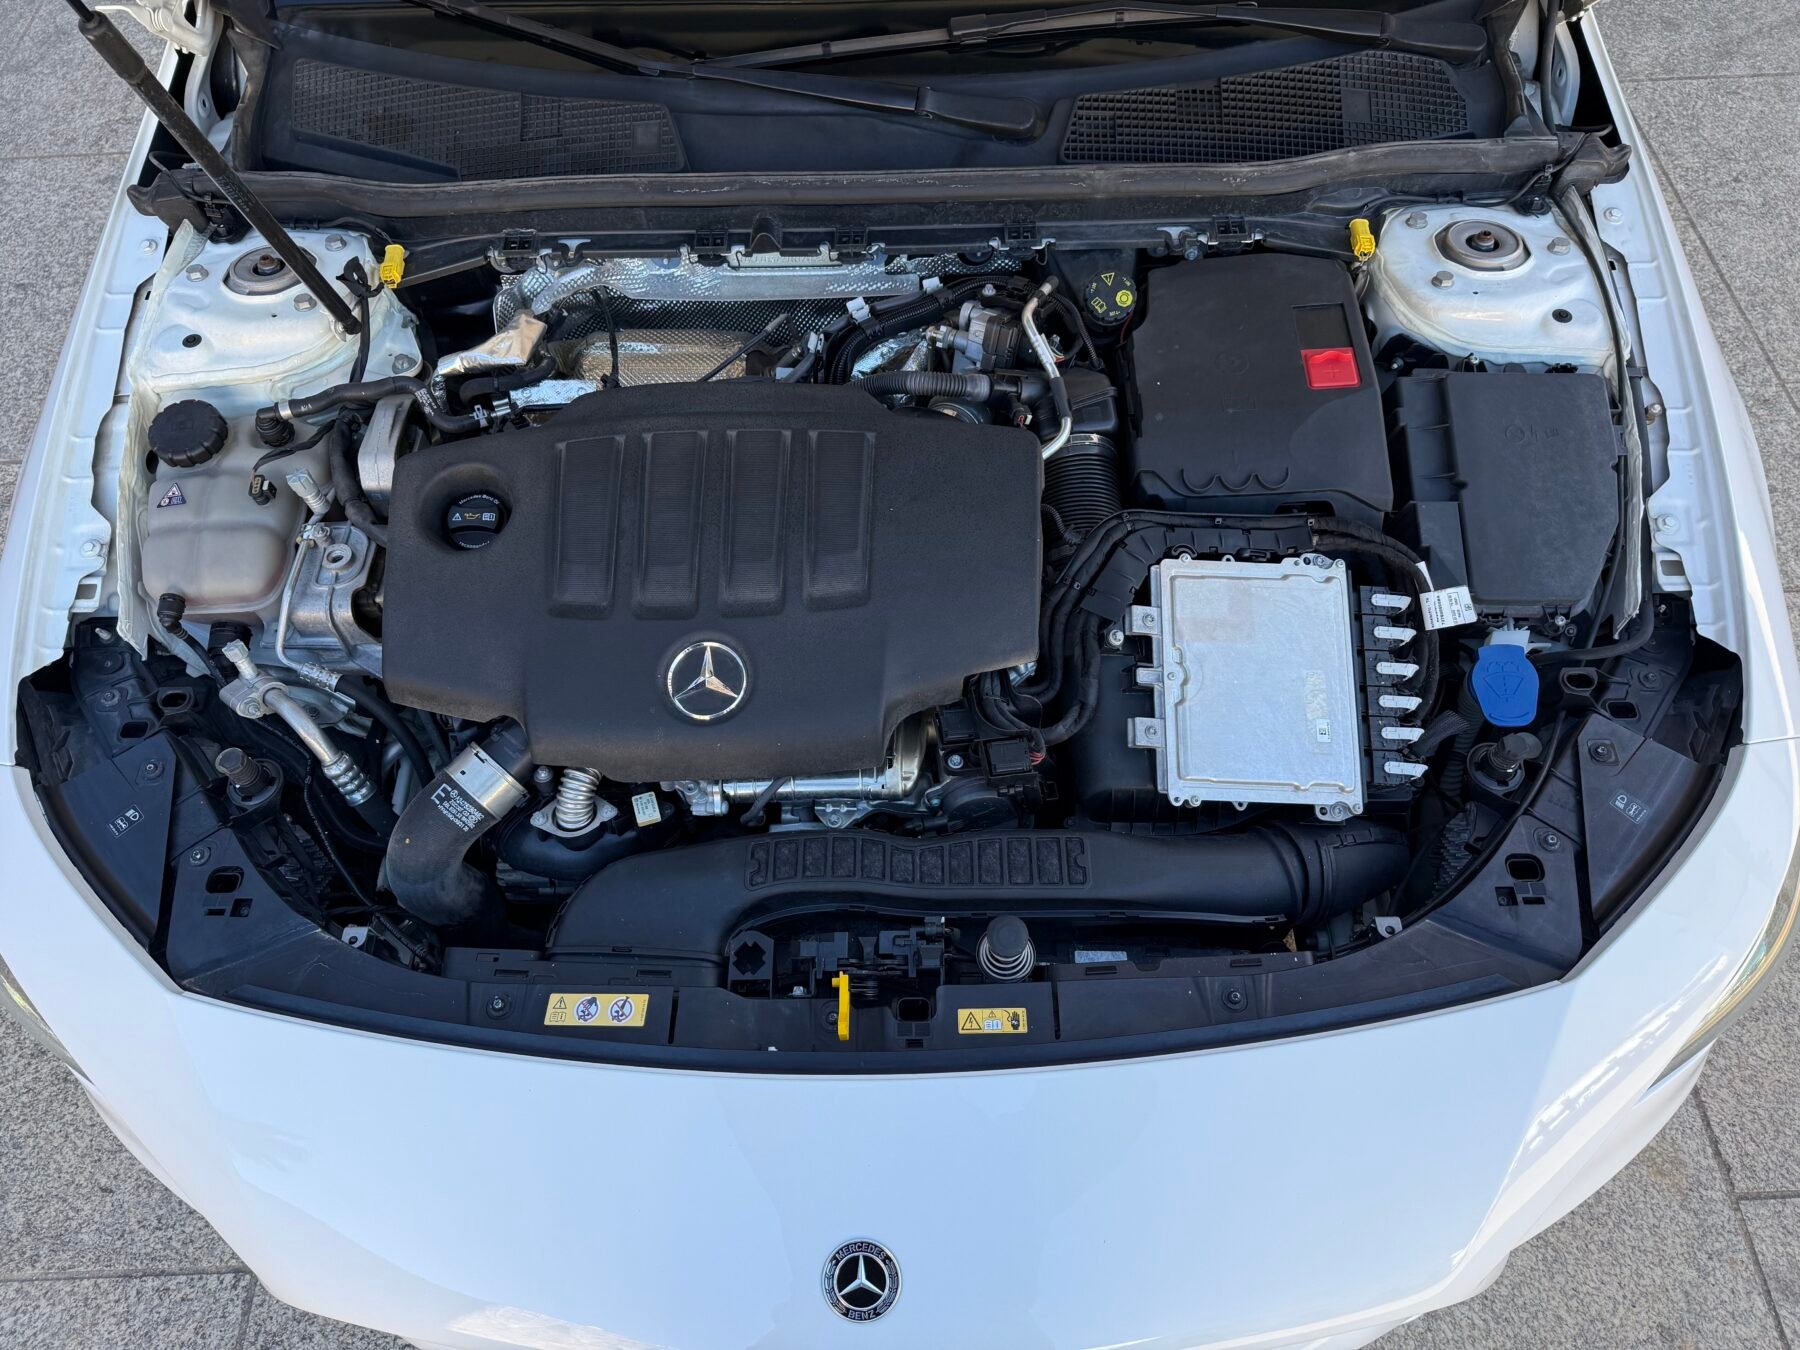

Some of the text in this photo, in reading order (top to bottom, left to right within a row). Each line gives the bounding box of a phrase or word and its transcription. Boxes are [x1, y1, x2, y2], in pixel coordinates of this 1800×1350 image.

[431, 783, 452, 804] E
[836, 1243, 886, 1260] MERCEDES
[848, 1310, 876, 1320] BENZ
